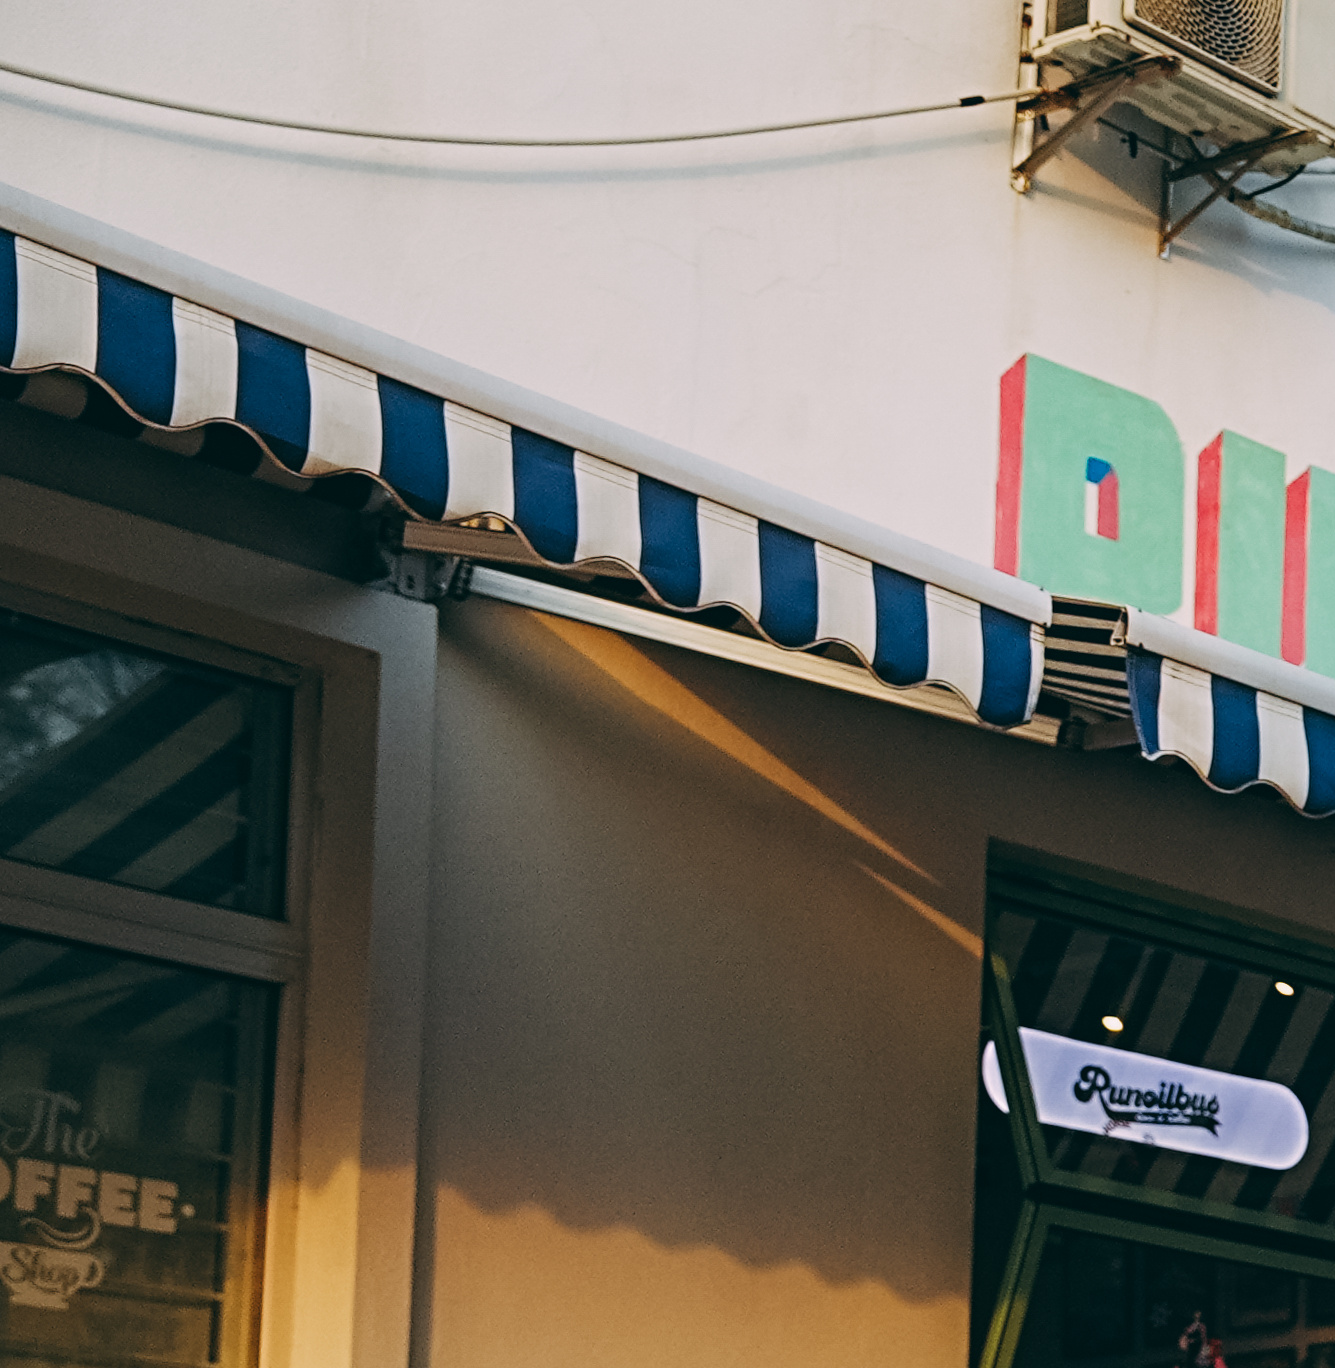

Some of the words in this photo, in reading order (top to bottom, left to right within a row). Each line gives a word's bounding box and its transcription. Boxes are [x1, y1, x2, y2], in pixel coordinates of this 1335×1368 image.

[1074, 1065, 1219, 1115] Runoilbus
[0, 1087, 101, 1160] The
[0, 1157, 179, 1235] FFEE
[2, 1246, 82, 1292] Shop
